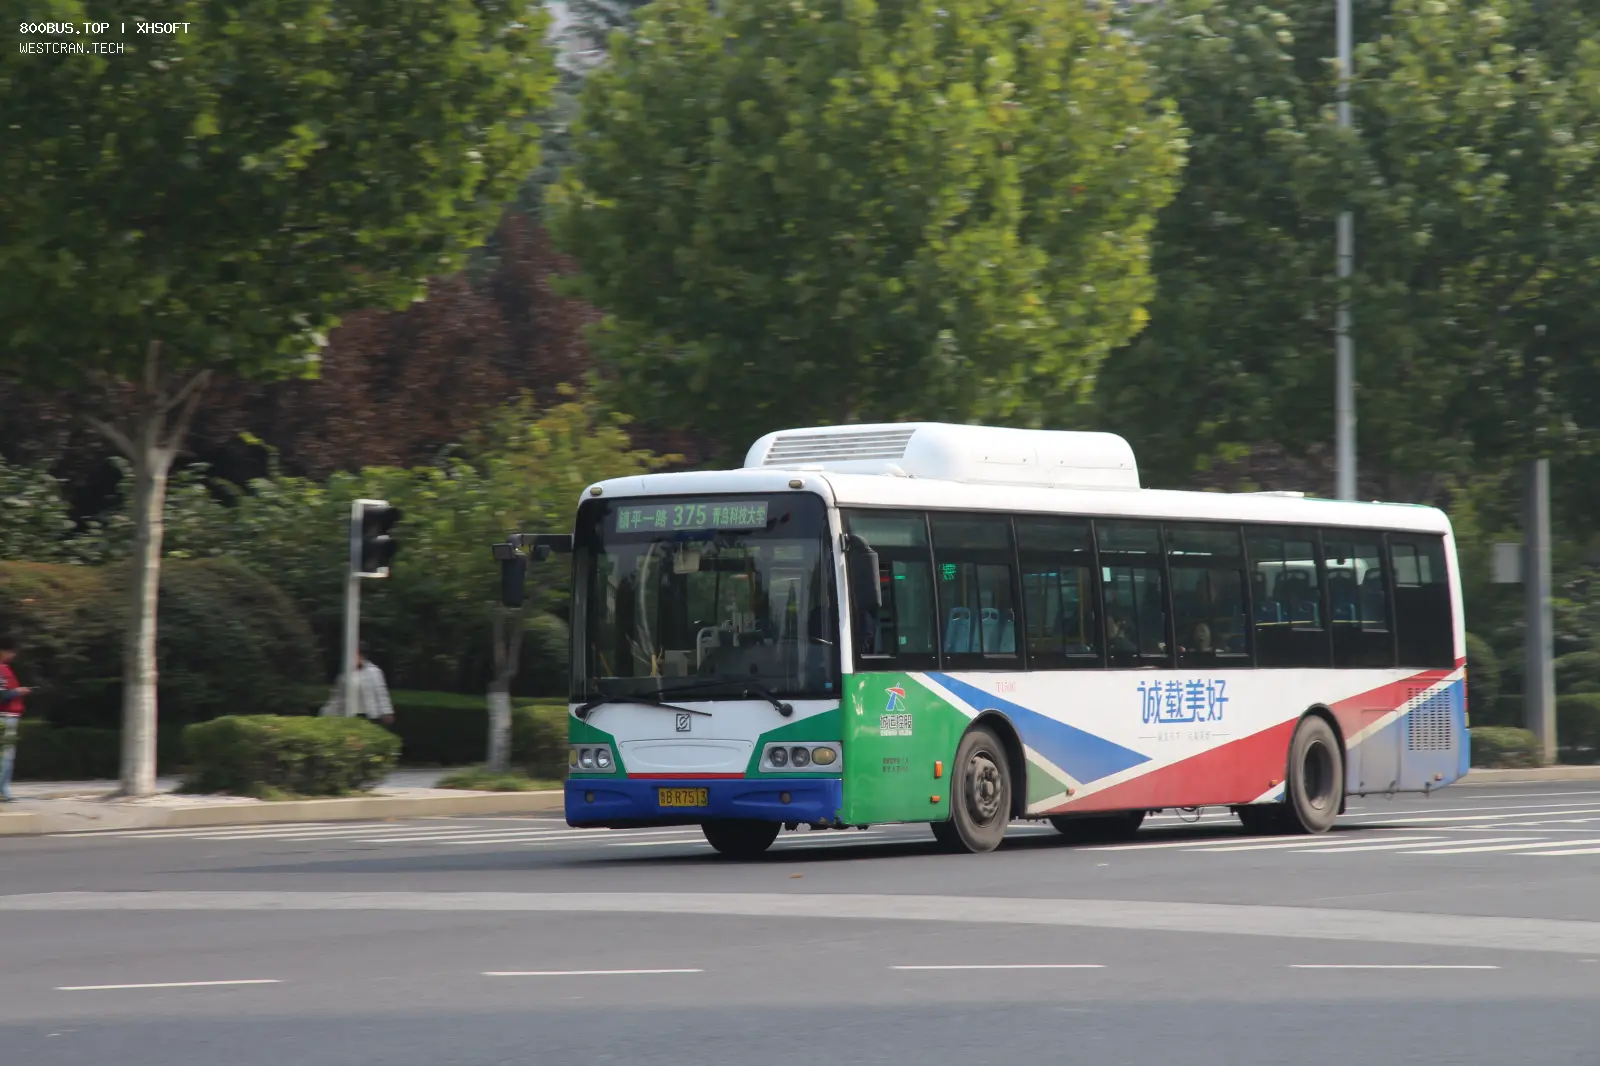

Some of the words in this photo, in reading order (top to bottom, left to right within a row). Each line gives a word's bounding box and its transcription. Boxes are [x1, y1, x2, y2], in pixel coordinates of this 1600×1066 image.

[673, 504, 707, 526] 375
[1137, 679, 1229, 724] 诚载美好
[880, 714, 912, 729] 城运控股
